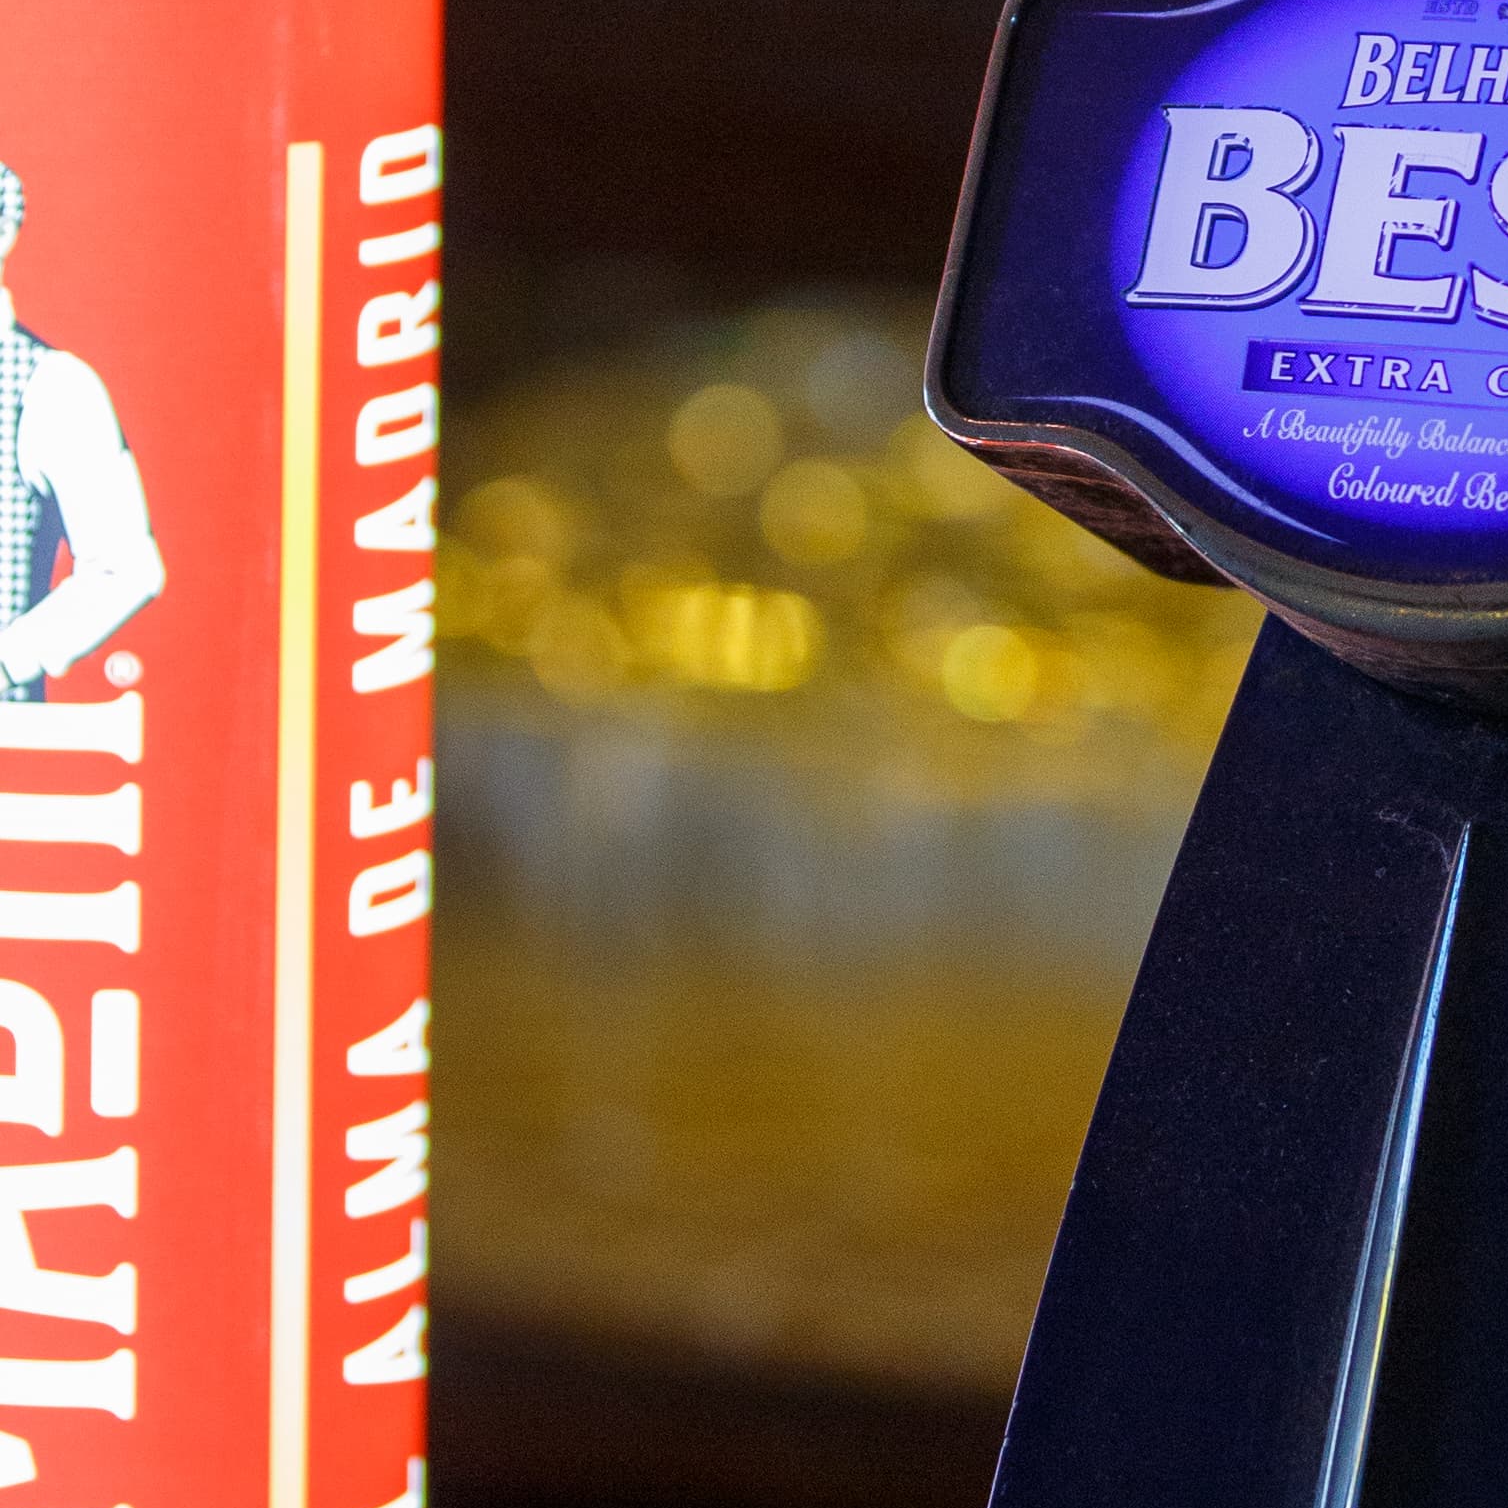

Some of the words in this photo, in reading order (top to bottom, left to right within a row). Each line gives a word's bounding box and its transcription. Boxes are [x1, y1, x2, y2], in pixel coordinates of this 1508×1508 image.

[351, 123, 443, 694] MADRID
[1269, 349, 1453, 393] EXTRA
[1243, 408, 1275, 440] A
[1277, 408, 1414, 459] Beautifully
[1328, 461, 1460, 509] Coloured
[347, 756, 435, 939] DE
[342, 998, 432, 1387] ALMA
